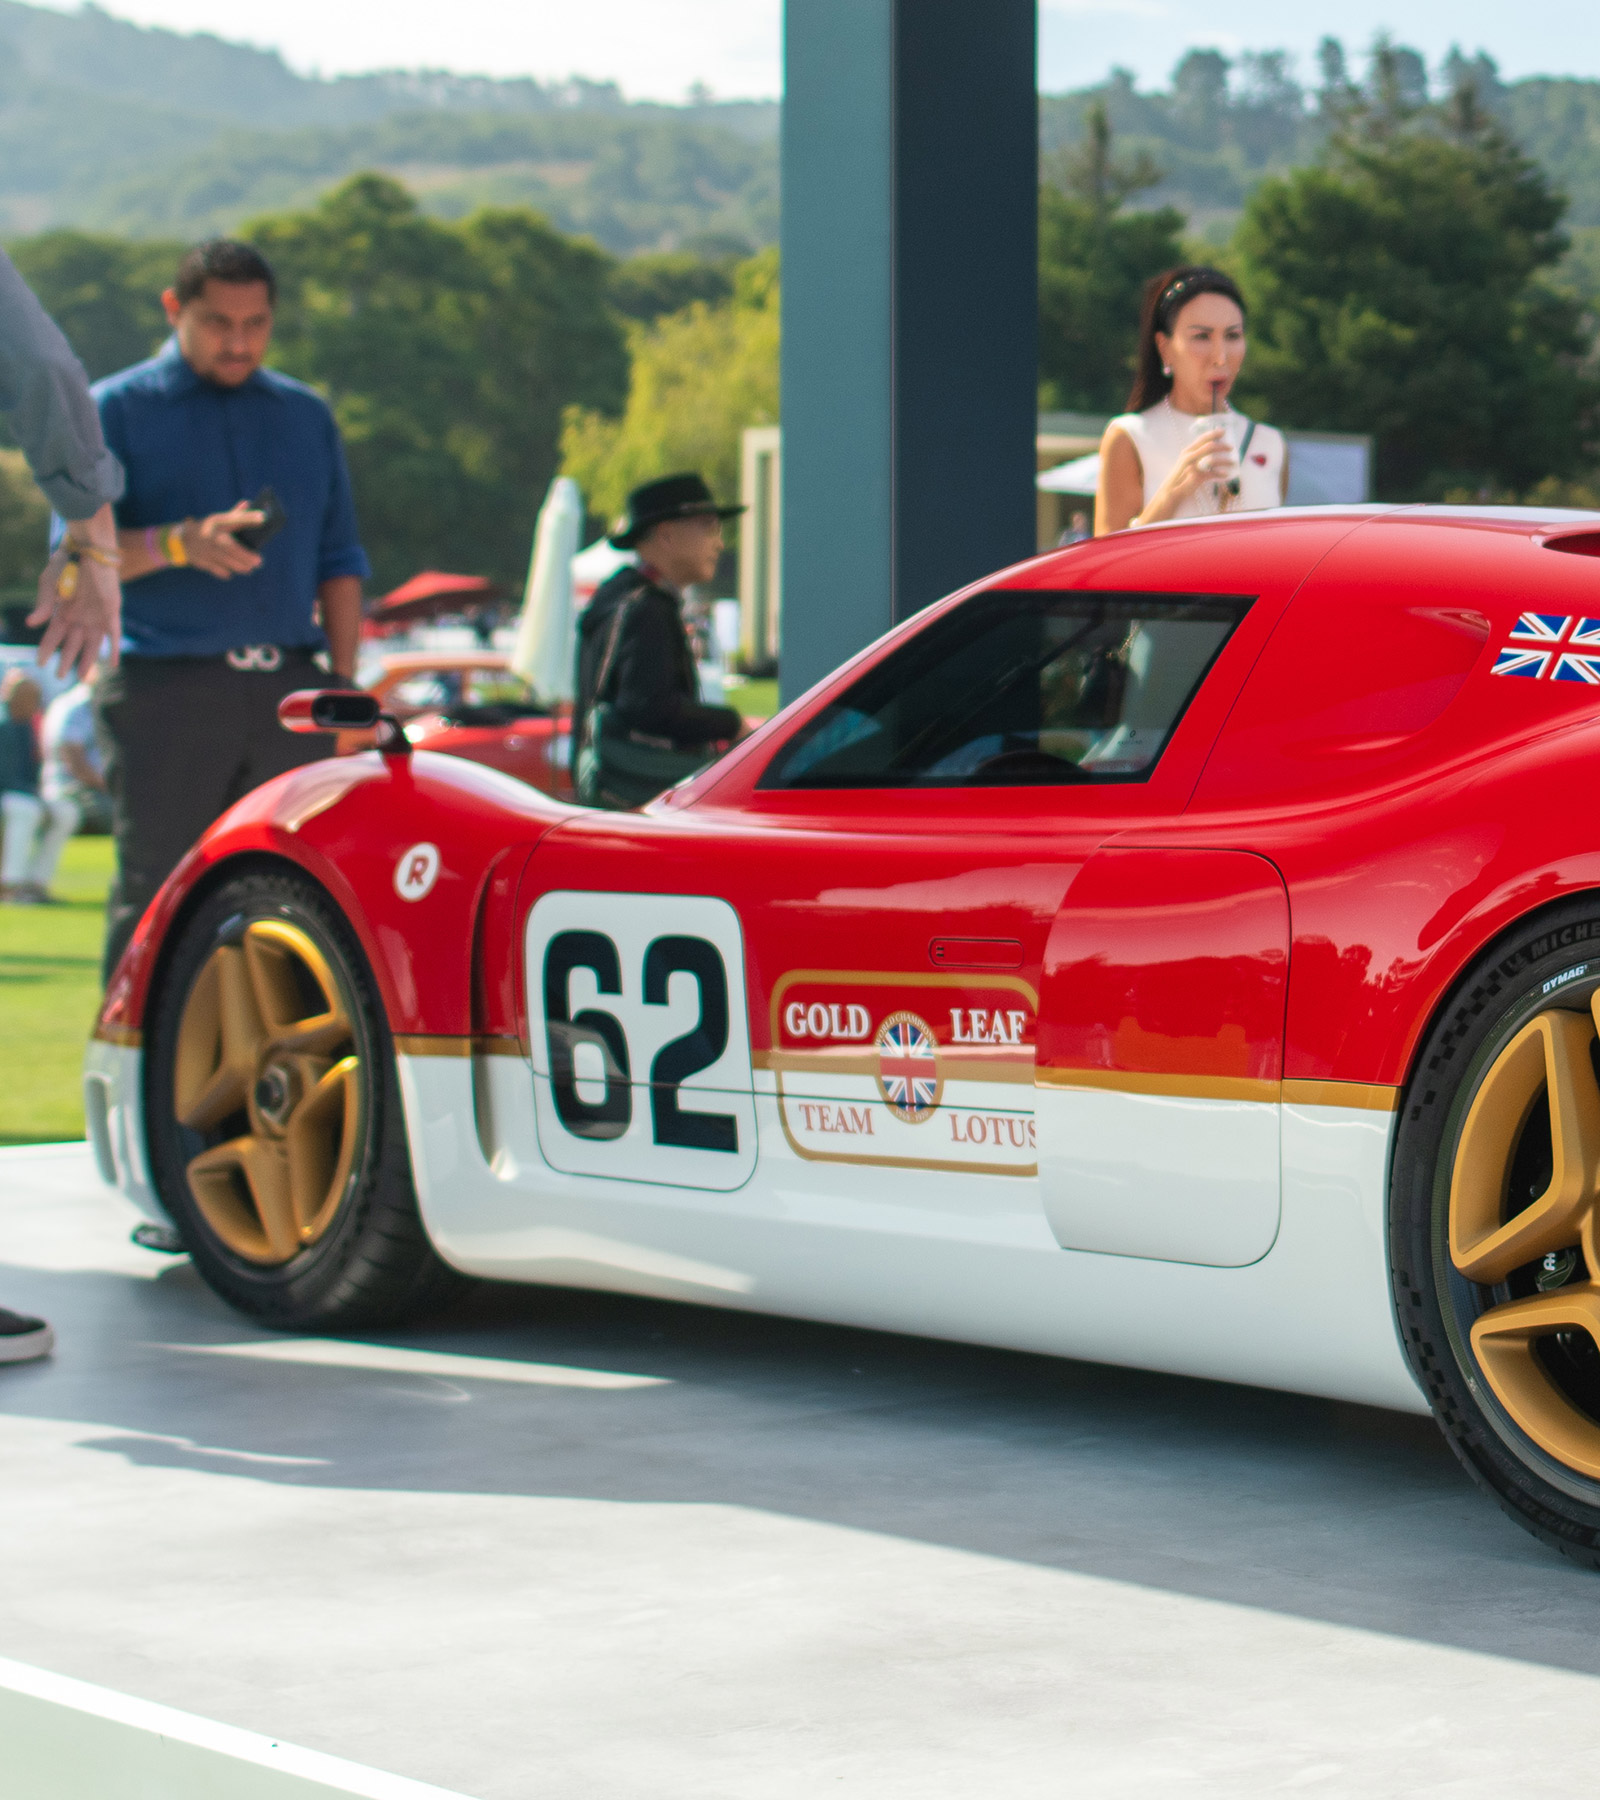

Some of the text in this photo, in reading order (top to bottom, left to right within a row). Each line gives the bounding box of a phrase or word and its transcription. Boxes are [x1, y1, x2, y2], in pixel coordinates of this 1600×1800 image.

[1542, 965, 1586, 994] DYMAG
[786, 1002, 869, 1038] GOLD
[951, 1008, 1025, 1044] LEAF
[543, 930, 739, 1154] 62
[800, 1104, 874, 1135] TEAM
